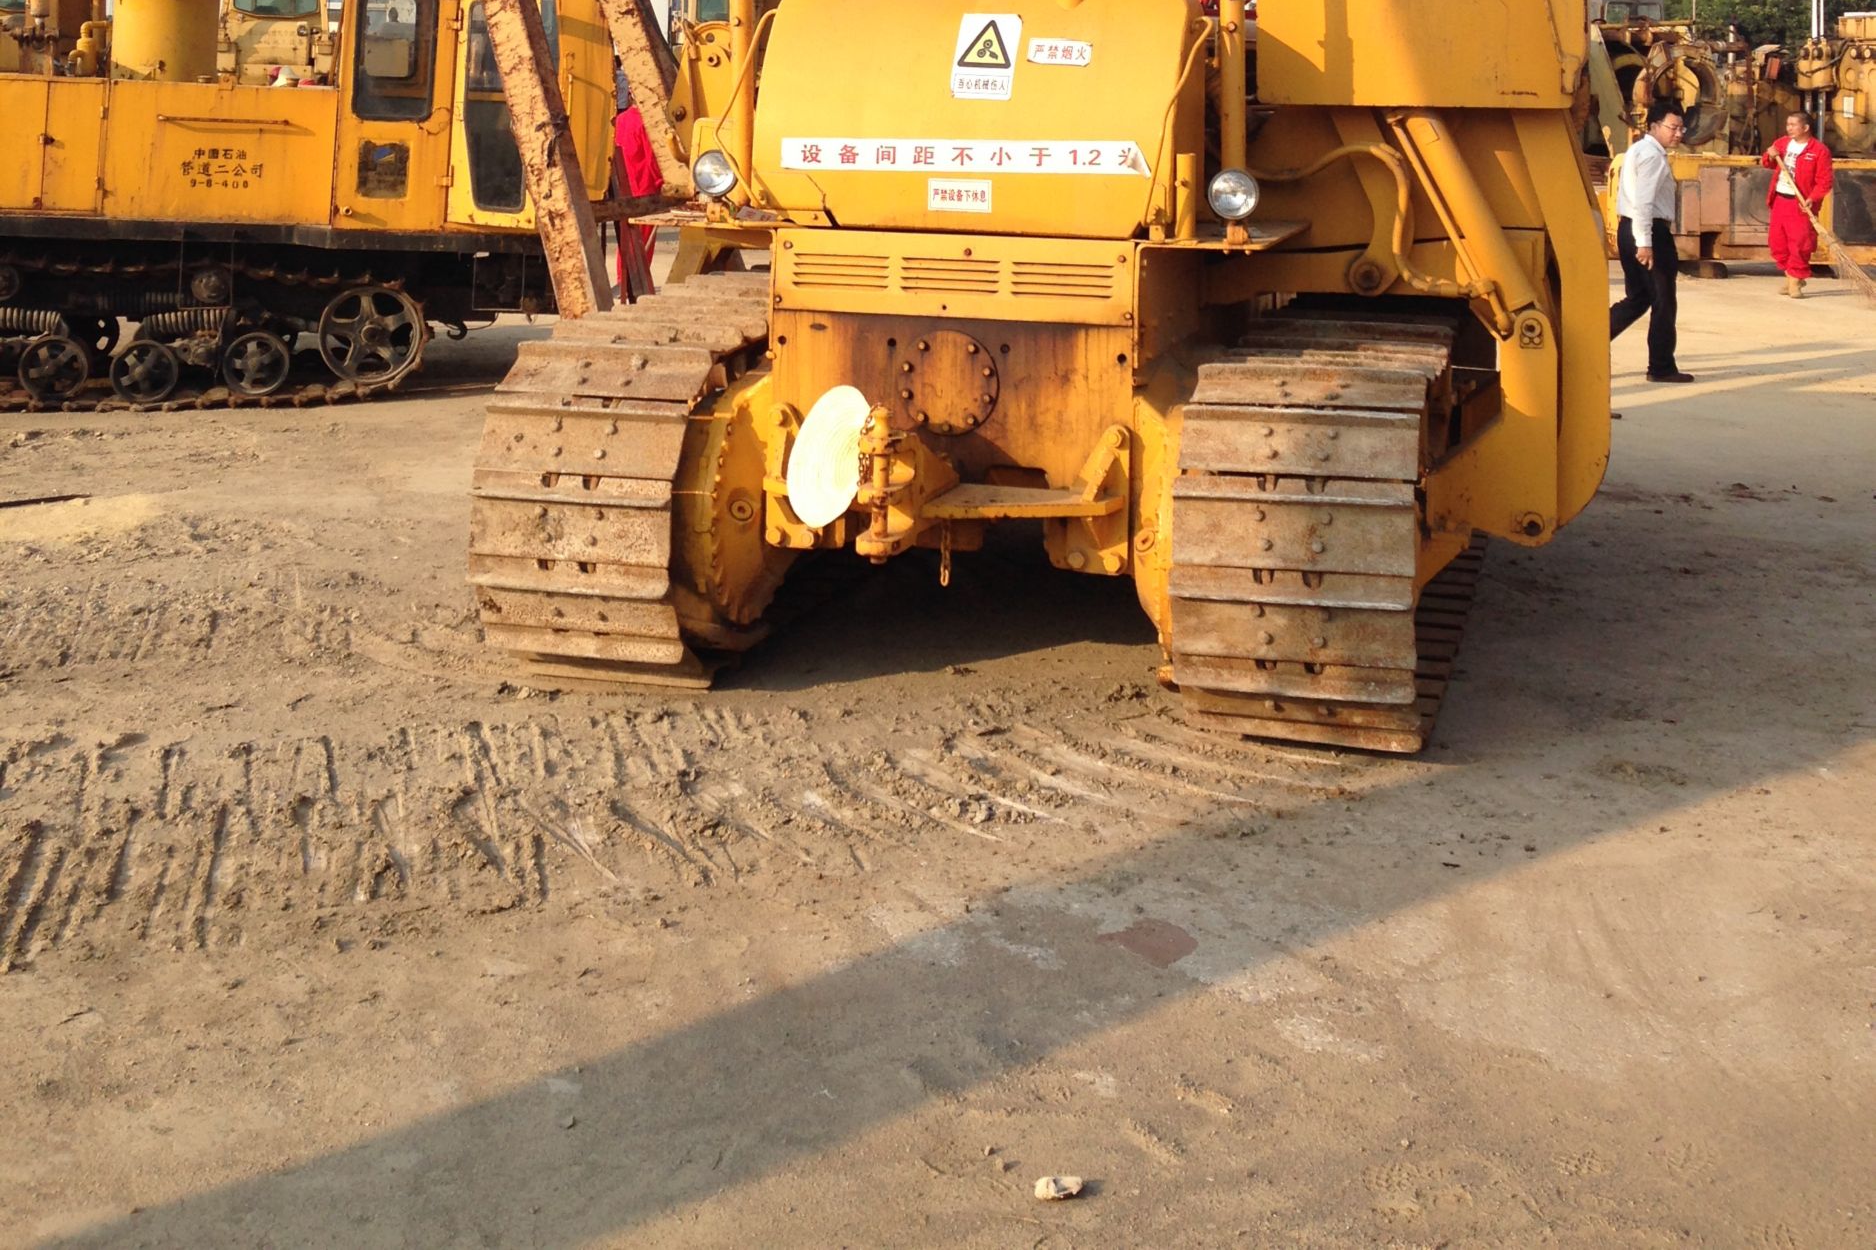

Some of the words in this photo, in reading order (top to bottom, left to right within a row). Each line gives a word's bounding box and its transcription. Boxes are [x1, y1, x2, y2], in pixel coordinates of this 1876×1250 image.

[1033, 44, 1087, 60] 严禁烟火
[957, 78, 1006, 91] 当心机械伤人
[180, 160, 264, 179] 管道二公司
[932, 188, 987, 203] 严禁设备下休息
